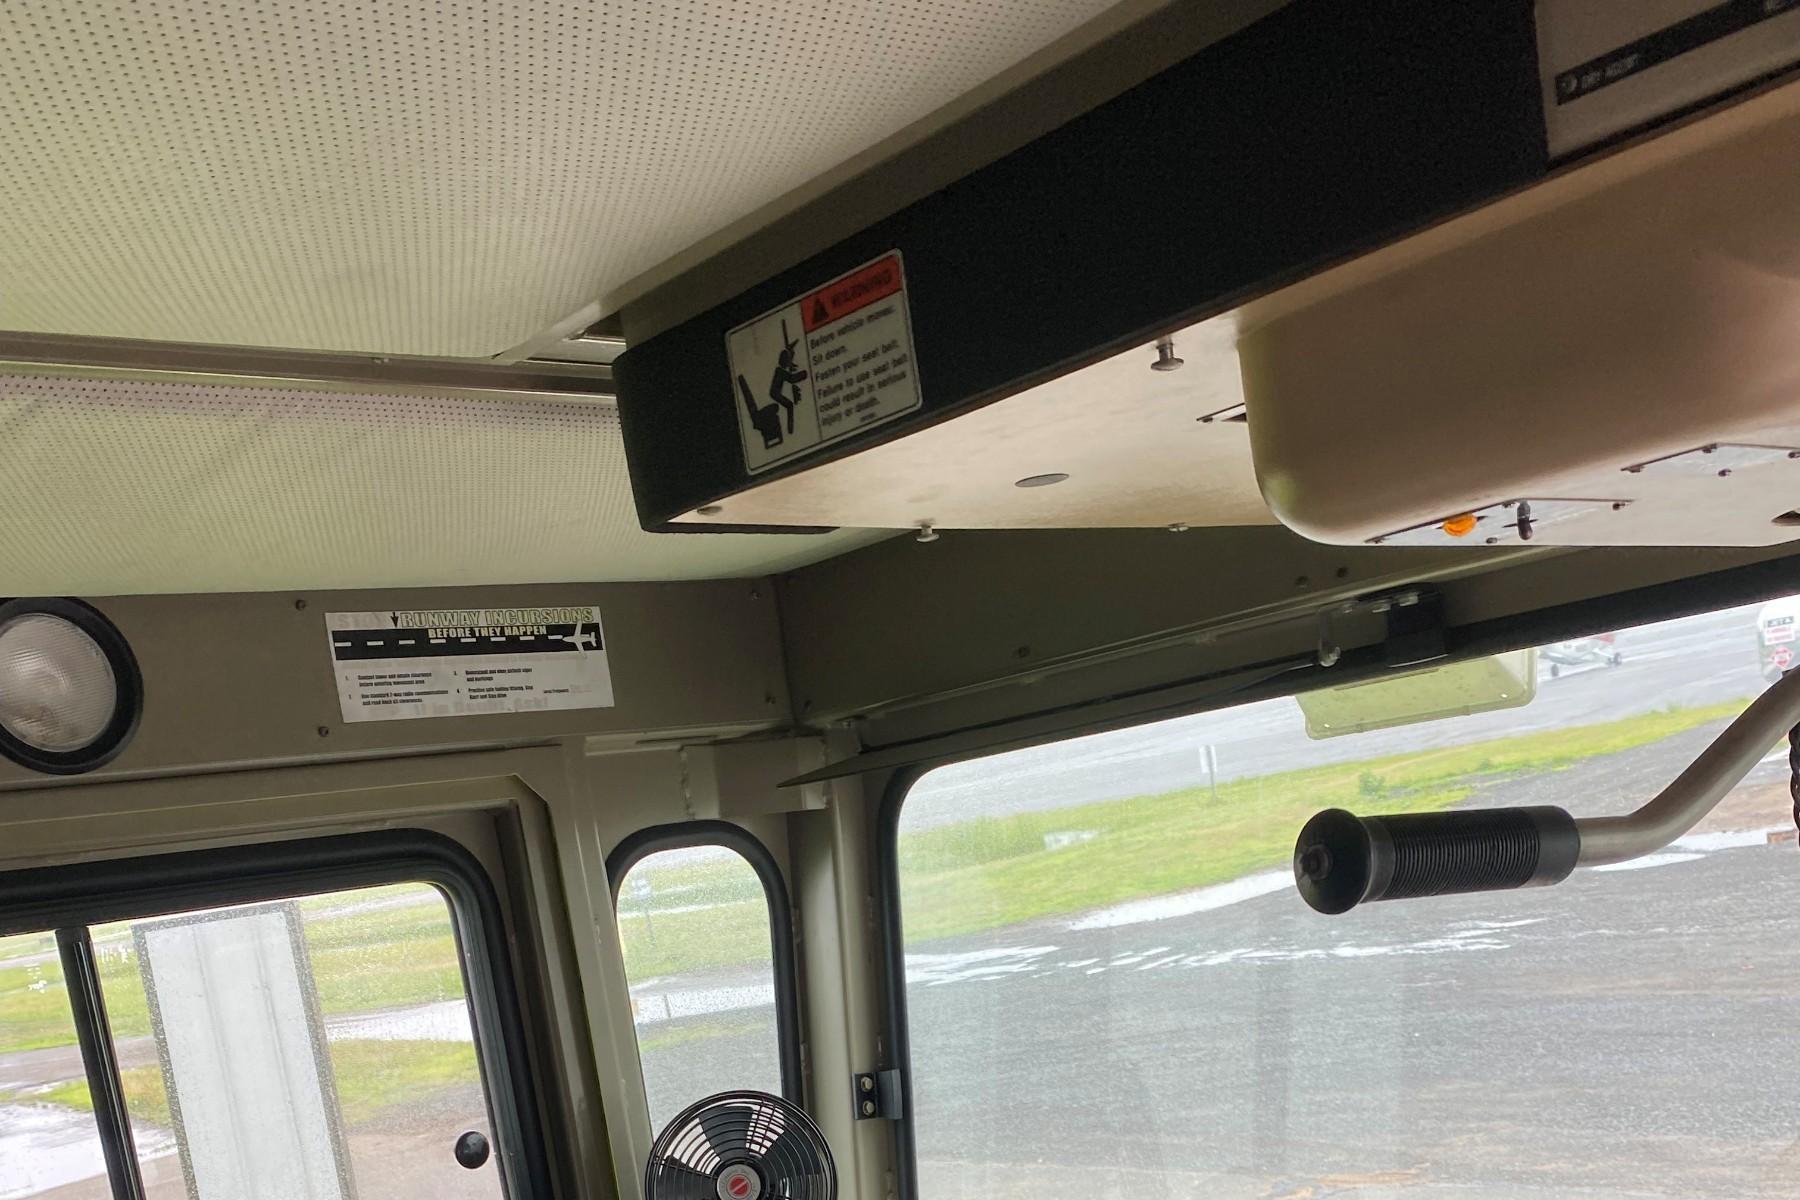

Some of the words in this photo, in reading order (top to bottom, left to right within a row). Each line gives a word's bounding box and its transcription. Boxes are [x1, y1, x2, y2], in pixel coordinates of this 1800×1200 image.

[810, 333, 835, 350] Before
[812, 353, 823, 366] Sit
[815, 365, 841, 382] Fasten
[843, 356, 860, 373] your
[862, 347, 879, 361] seat
[818, 382, 843, 399] Failure
[846, 378, 854, 387] to
[857, 371, 870, 383] use
[873, 361, 889, 376] seat
[820, 397, 841, 412] could
[843, 386, 864, 402] result
[867, 383, 874, 392] in
[845, 408, 853, 416] or
[401, 610, 480, 627] RUNWAY
[487, 607, 594, 625] INCURSIONS
[428, 628, 471, 638] BEFORE
[476, 627, 500, 637] THEY
[505, 625, 547, 635] HAPPEN
